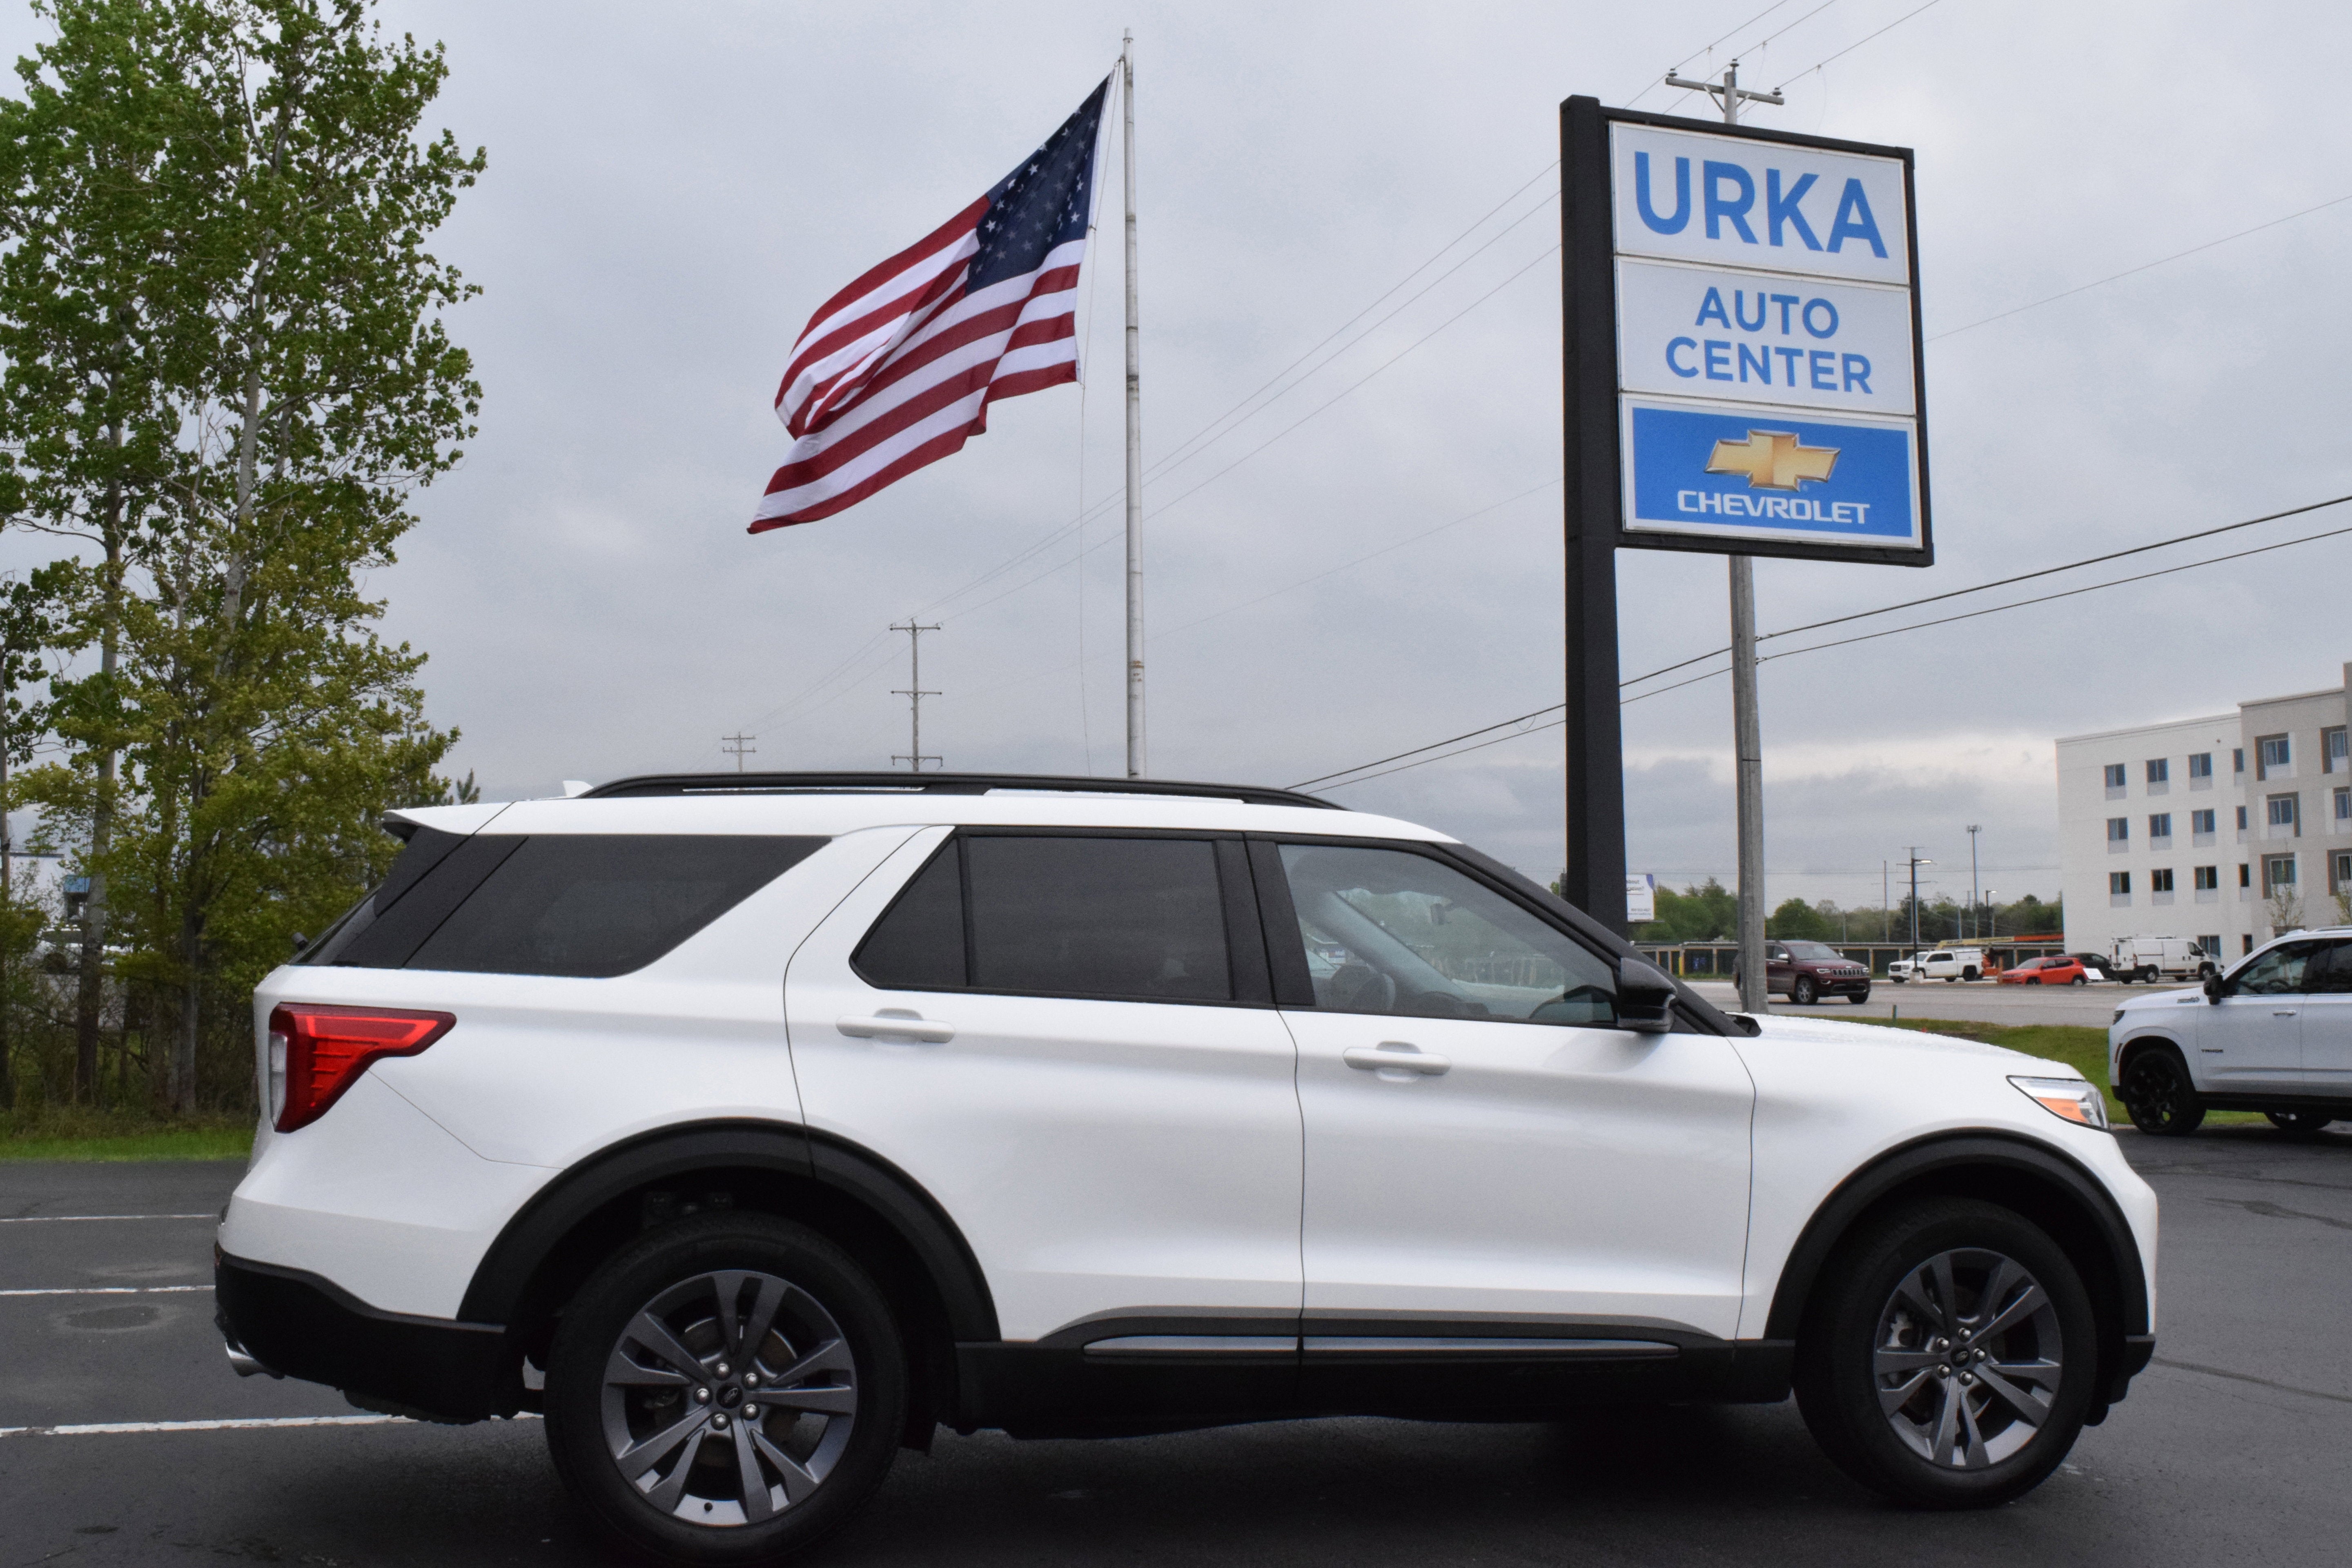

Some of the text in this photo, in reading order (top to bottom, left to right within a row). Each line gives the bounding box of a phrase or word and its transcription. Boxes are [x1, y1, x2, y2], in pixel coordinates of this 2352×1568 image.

[1635, 151, 1889, 258] URKA
[1695, 287, 1840, 339] AUTO
[1666, 336, 1873, 394] CENTER
[1677, 490, 1870, 524] CHEVROLET
